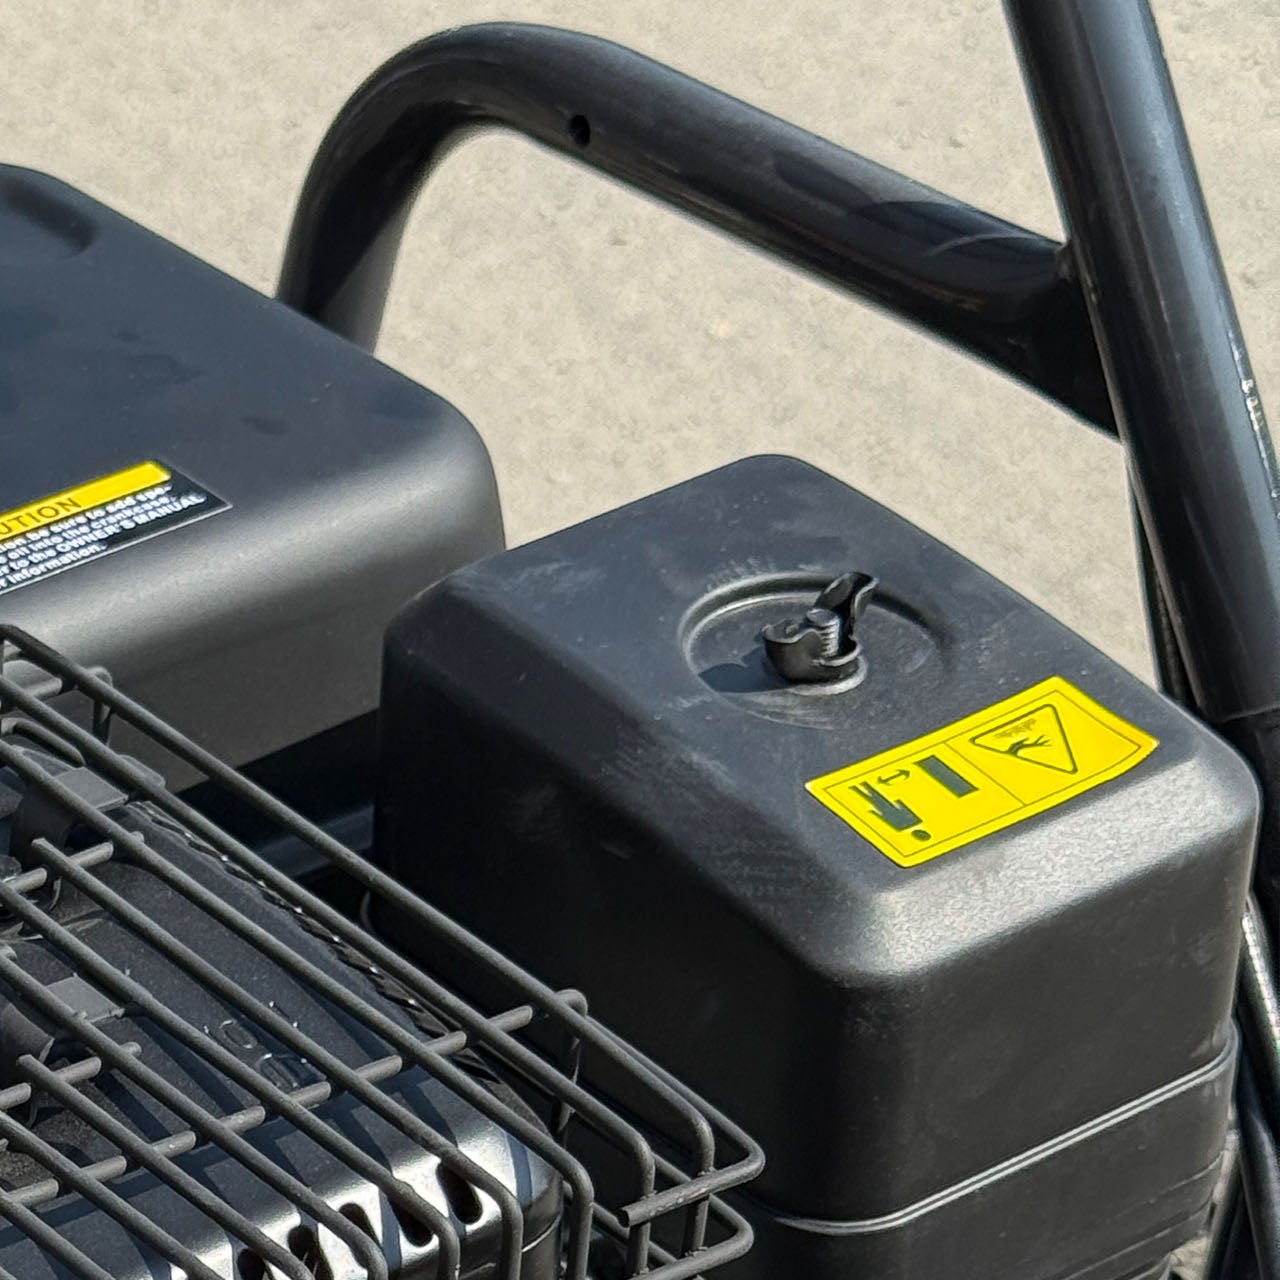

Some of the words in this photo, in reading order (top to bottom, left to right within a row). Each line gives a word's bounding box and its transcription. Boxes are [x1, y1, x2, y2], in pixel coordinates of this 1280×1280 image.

[8, 558, 30, 571] to
[27, 547, 57, 563] the
[55, 518, 136, 553] OWNER'S
[131, 494, 206, 525] MANUAL
[49, 514, 88, 534] sure
[85, 508, 107, 520] to
[105, 496, 137, 514] add
[7, 546, 34, 560] oil
[27, 534, 64, 552] into
[61, 524, 91, 540] the
